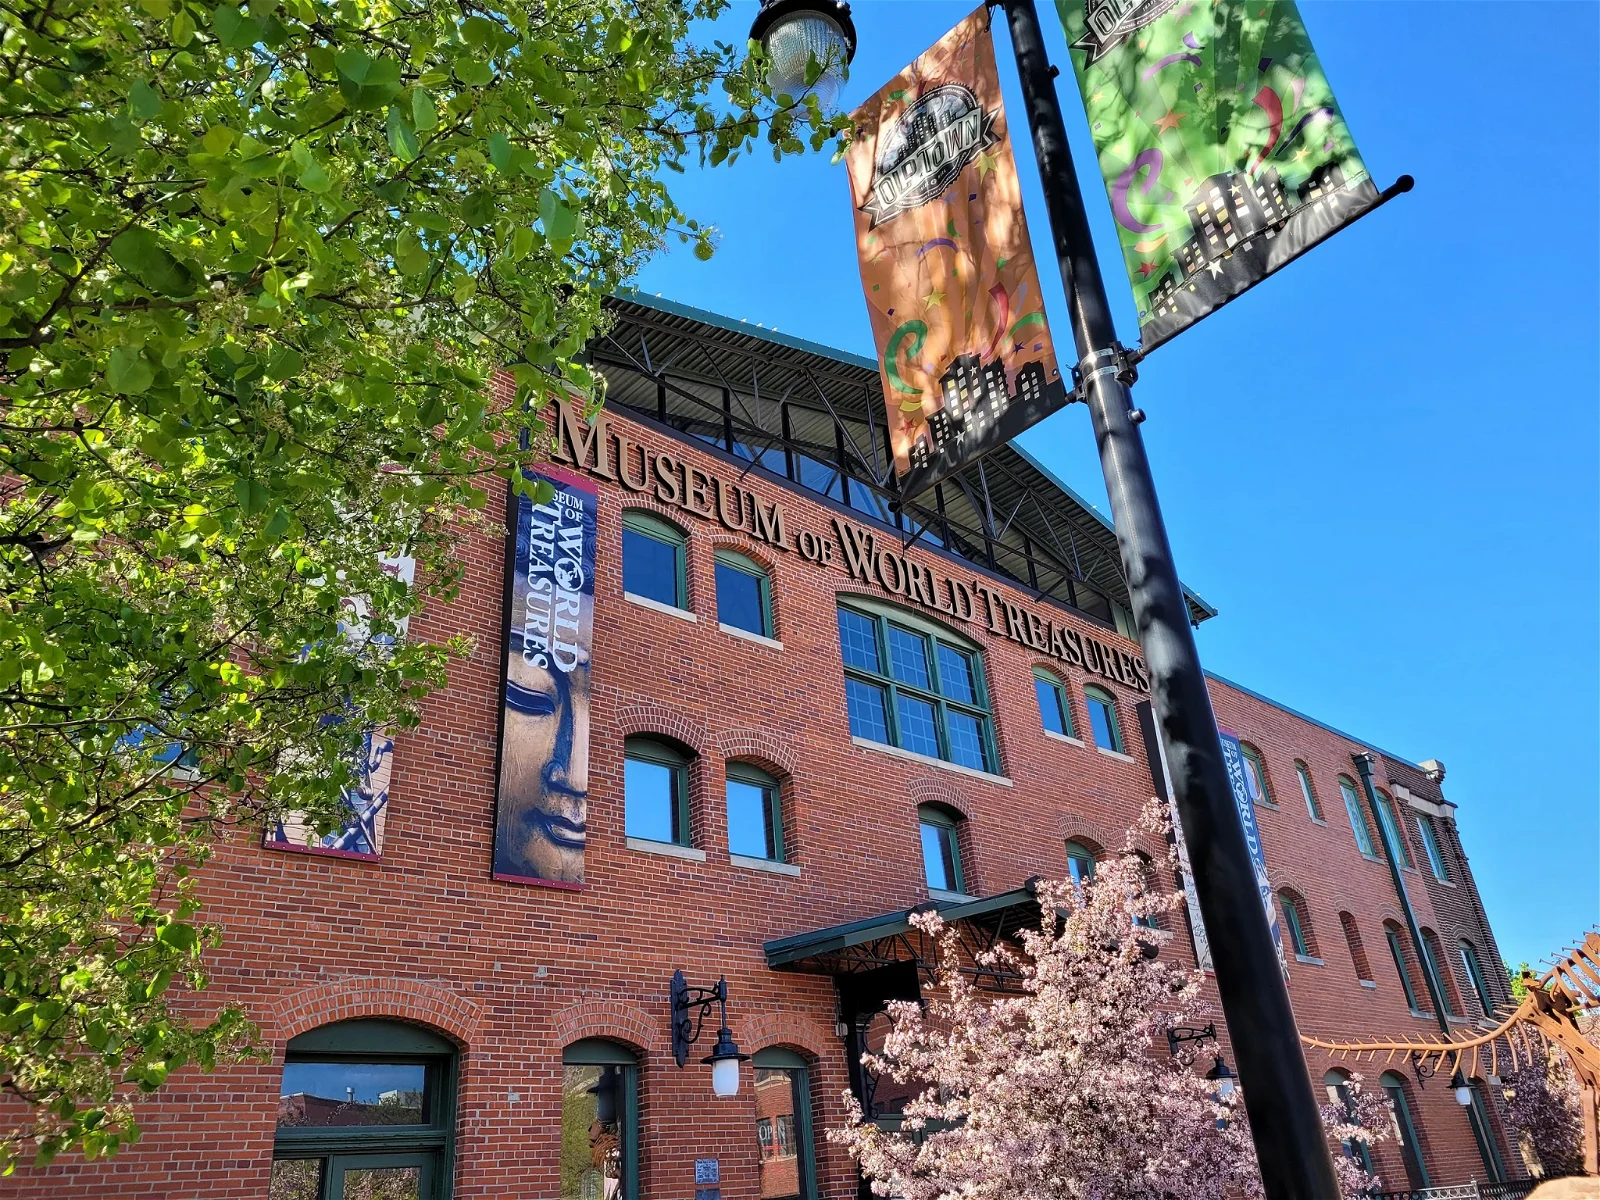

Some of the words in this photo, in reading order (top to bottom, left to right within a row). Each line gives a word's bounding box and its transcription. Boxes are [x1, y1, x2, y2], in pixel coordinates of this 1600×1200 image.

[551, 397, 793, 551] MUSEUM
[797, 528, 833, 566] OF
[831, 517, 977, 622] WORLD
[974, 580, 1150, 692] TREASURES
[552, 489, 584, 511] SEUM
[564, 508, 583, 523] OF
[522, 502, 563, 670] TREASURES
[553, 524, 584, 673] WORLD
[1231, 759, 1258, 855] WORLD
